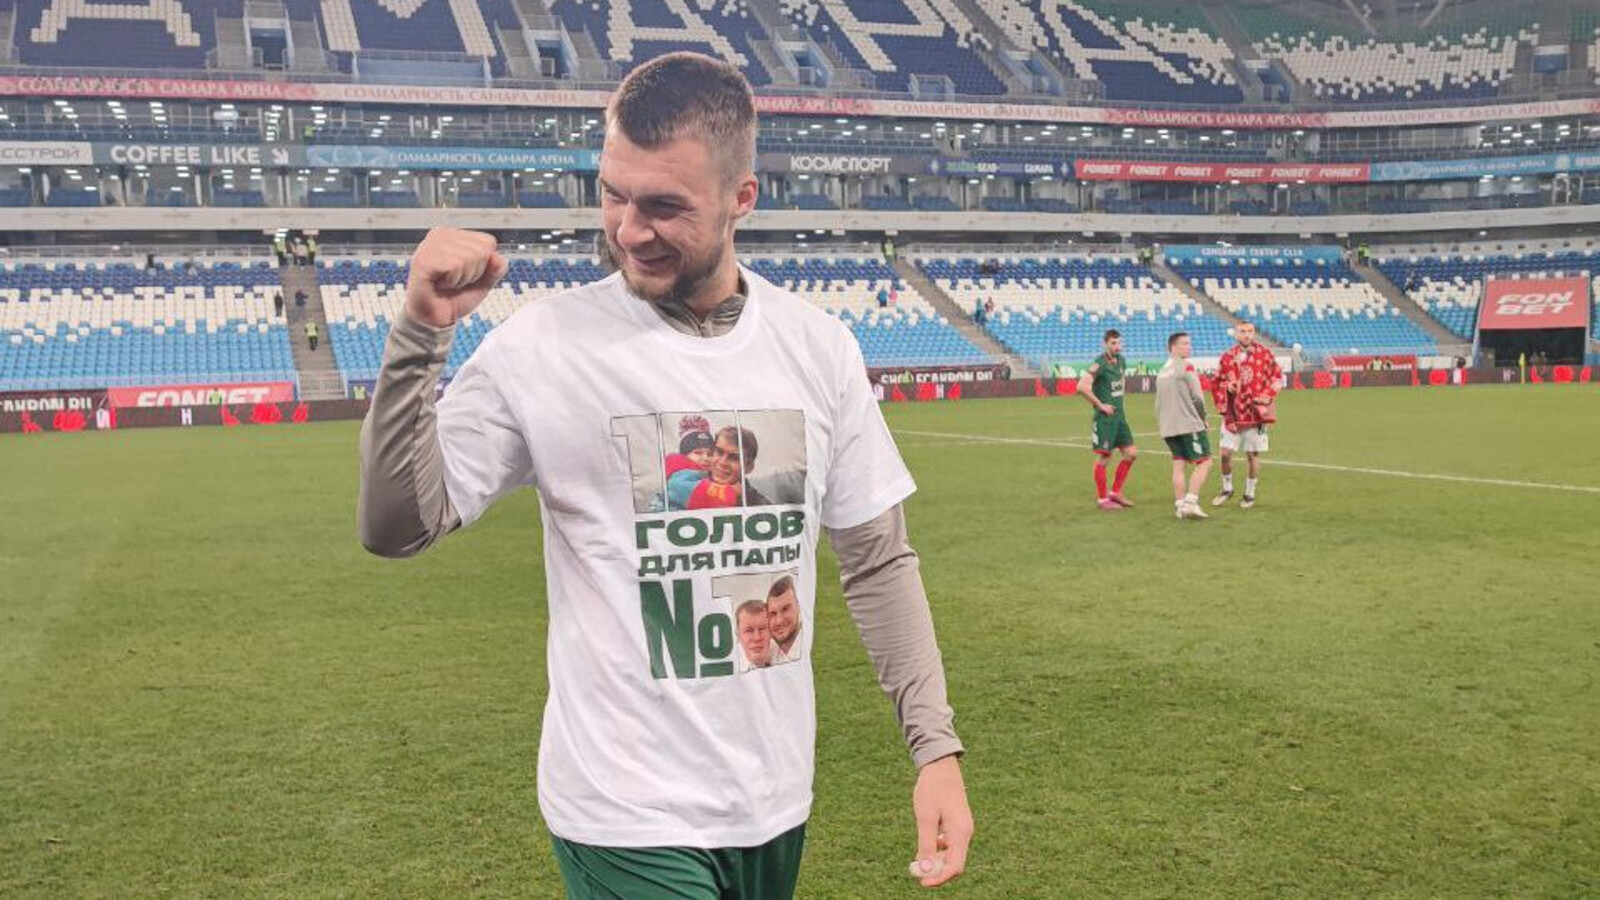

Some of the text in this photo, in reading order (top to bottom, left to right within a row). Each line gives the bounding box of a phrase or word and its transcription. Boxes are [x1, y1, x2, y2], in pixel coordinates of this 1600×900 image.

[159, 82, 228, 95] САМАРА
[232, 84, 283, 97] АРЕНА
[469, 90, 532, 102] САМАРА
[1216, 113, 1262, 125] САМАРА
[110, 145, 261, 165] COFFEE LIKE
[390, 150, 575, 165] СОЛИДАРНОСТЬ САМАРА АРЕНА
[1083, 163, 1122, 174] FONBET
[1129, 164, 1168, 176] FONBET
[1174, 165, 1213, 177] FONBET
[1226, 167, 1264, 178] FONBET
[1271, 167, 1310, 178] FONBET
[1319, 167, 1361, 178] FONBET
[1496, 290, 1575, 305] FON
[1495, 302, 1574, 315] BET
[635, 510, 806, 549] ГОЛОВ
[638, 543, 801, 577] ДЛЯ ПАПЫ
